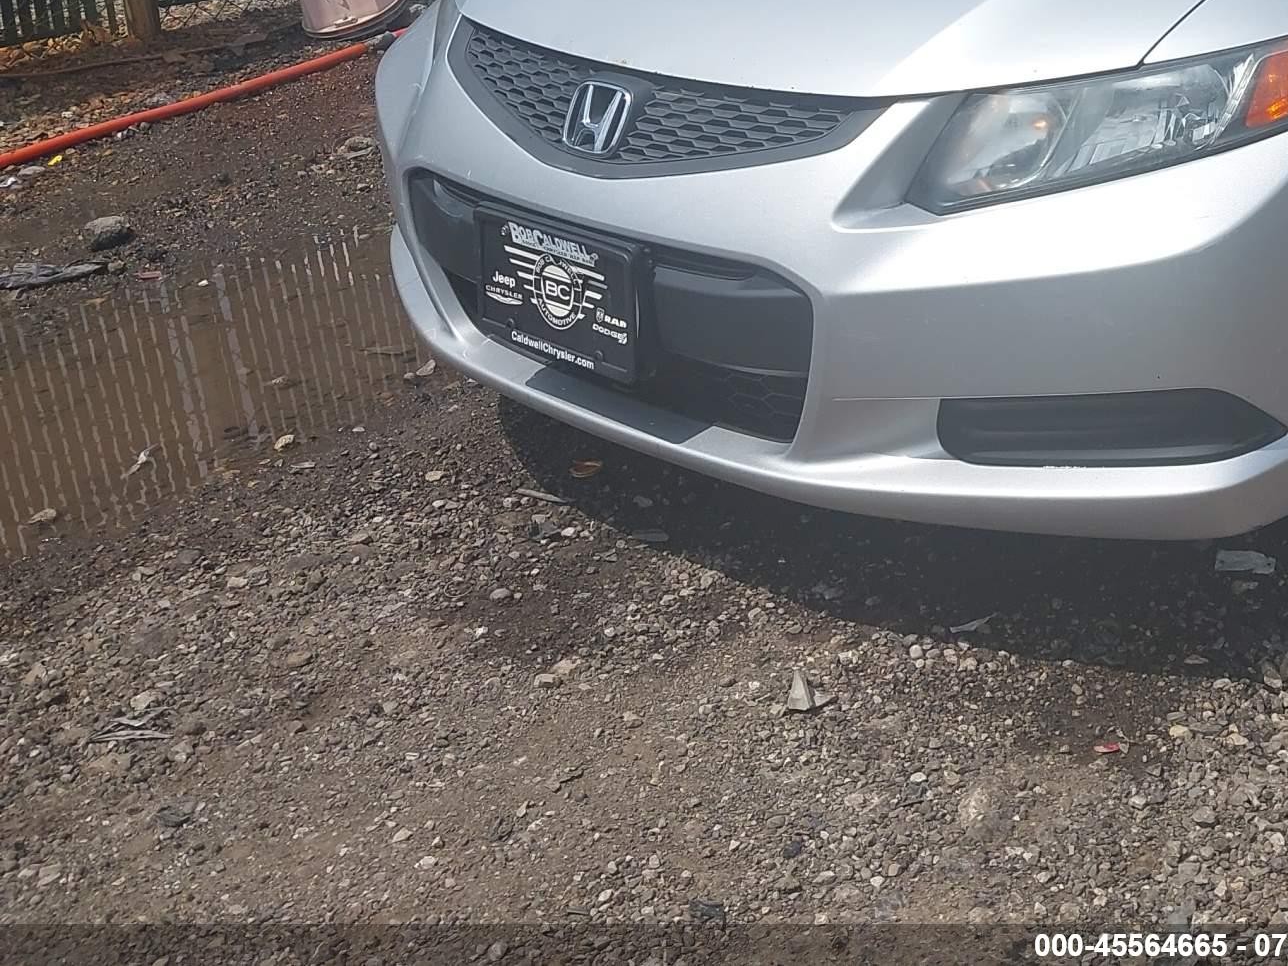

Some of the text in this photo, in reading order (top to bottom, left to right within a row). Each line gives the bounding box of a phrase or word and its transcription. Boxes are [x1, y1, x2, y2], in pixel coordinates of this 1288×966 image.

[492, 270, 516, 289] Jeep
[485, 284, 523, 300] CHRYSLER
[545, 280, 570, 301] BC
[537, 298, 577, 326] AUTOMOTIVE
[592, 323, 624, 340] DODGE
[511, 329, 595, 370] CaldwellChrysler.com
